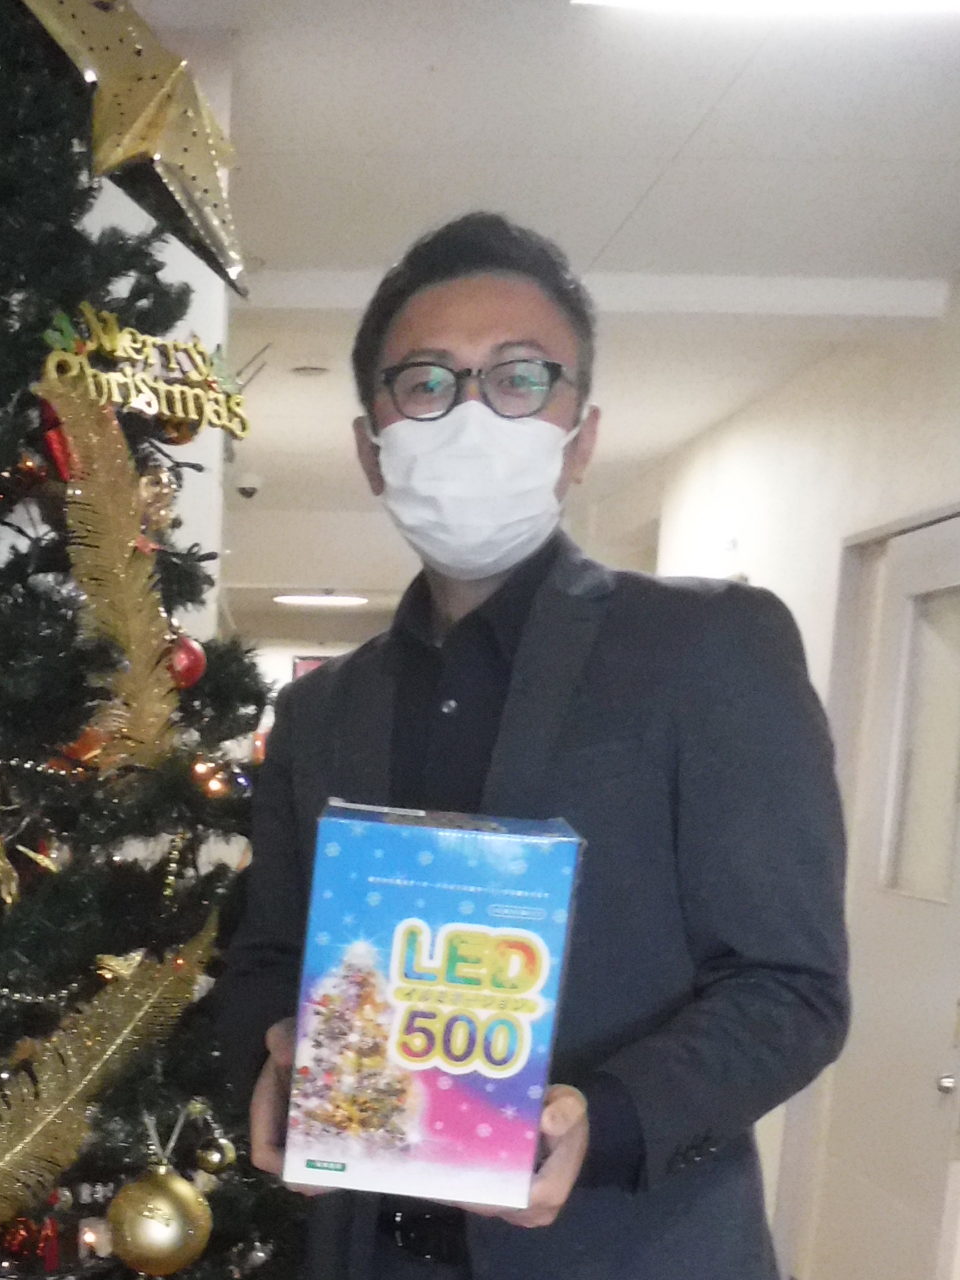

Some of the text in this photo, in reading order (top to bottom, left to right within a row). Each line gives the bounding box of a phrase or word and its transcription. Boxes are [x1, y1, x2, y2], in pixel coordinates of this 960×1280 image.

[80, 302, 210, 382] Merry
[46, 351, 250, 440] Christmas
[400, 926, 542, 993] LED
[398, 1009, 520, 1067] 500
